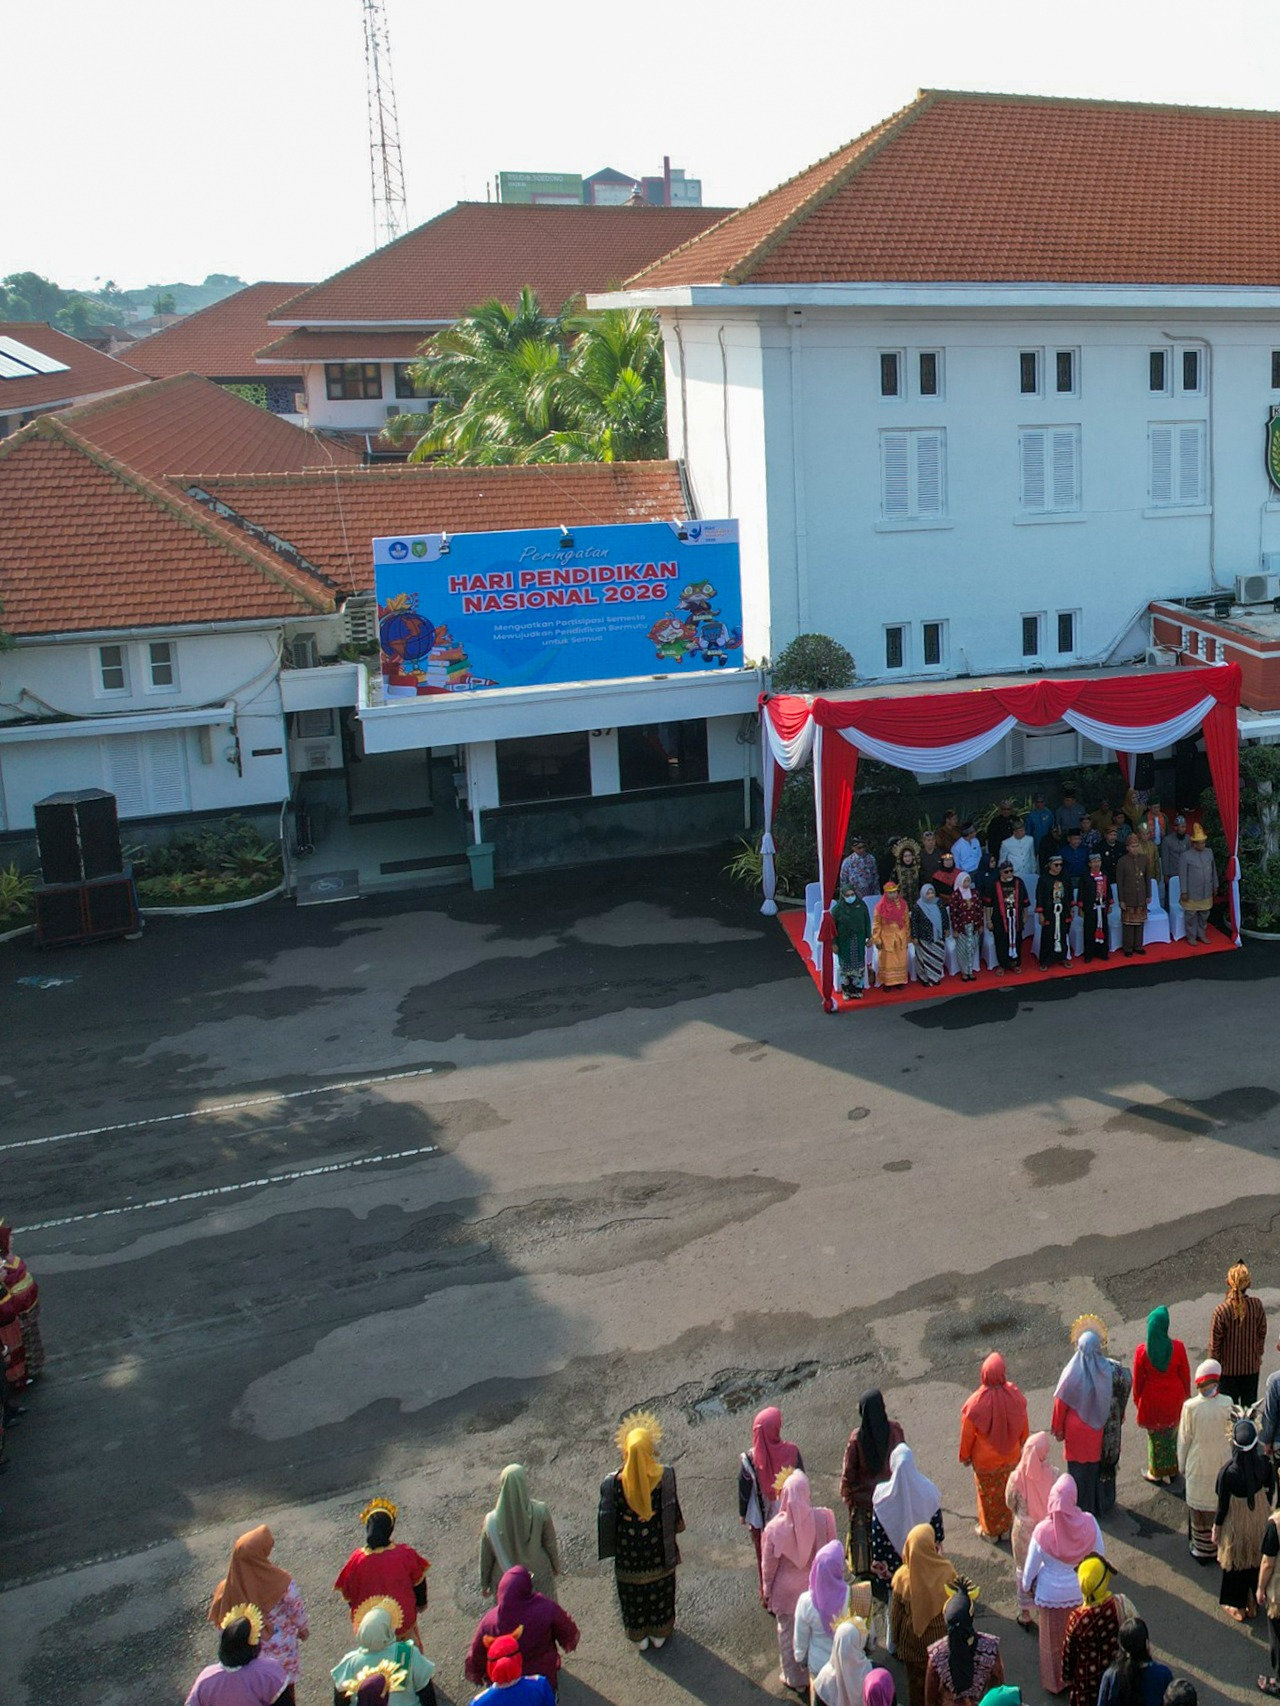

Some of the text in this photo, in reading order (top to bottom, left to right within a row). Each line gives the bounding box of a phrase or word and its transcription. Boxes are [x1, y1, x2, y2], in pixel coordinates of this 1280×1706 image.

[519, 546, 610, 566] Peringatan
[448, 561, 679, 594] HARI PENDIDIKAN
[462, 583, 669, 614] NASIONAL 2026
[494, 620, 554, 631] Menguatkan
[555, 617, 604, 627] Partisipasi
[555, 626, 606, 636] Pendidikan
[608, 623, 648, 631] Bermutu
